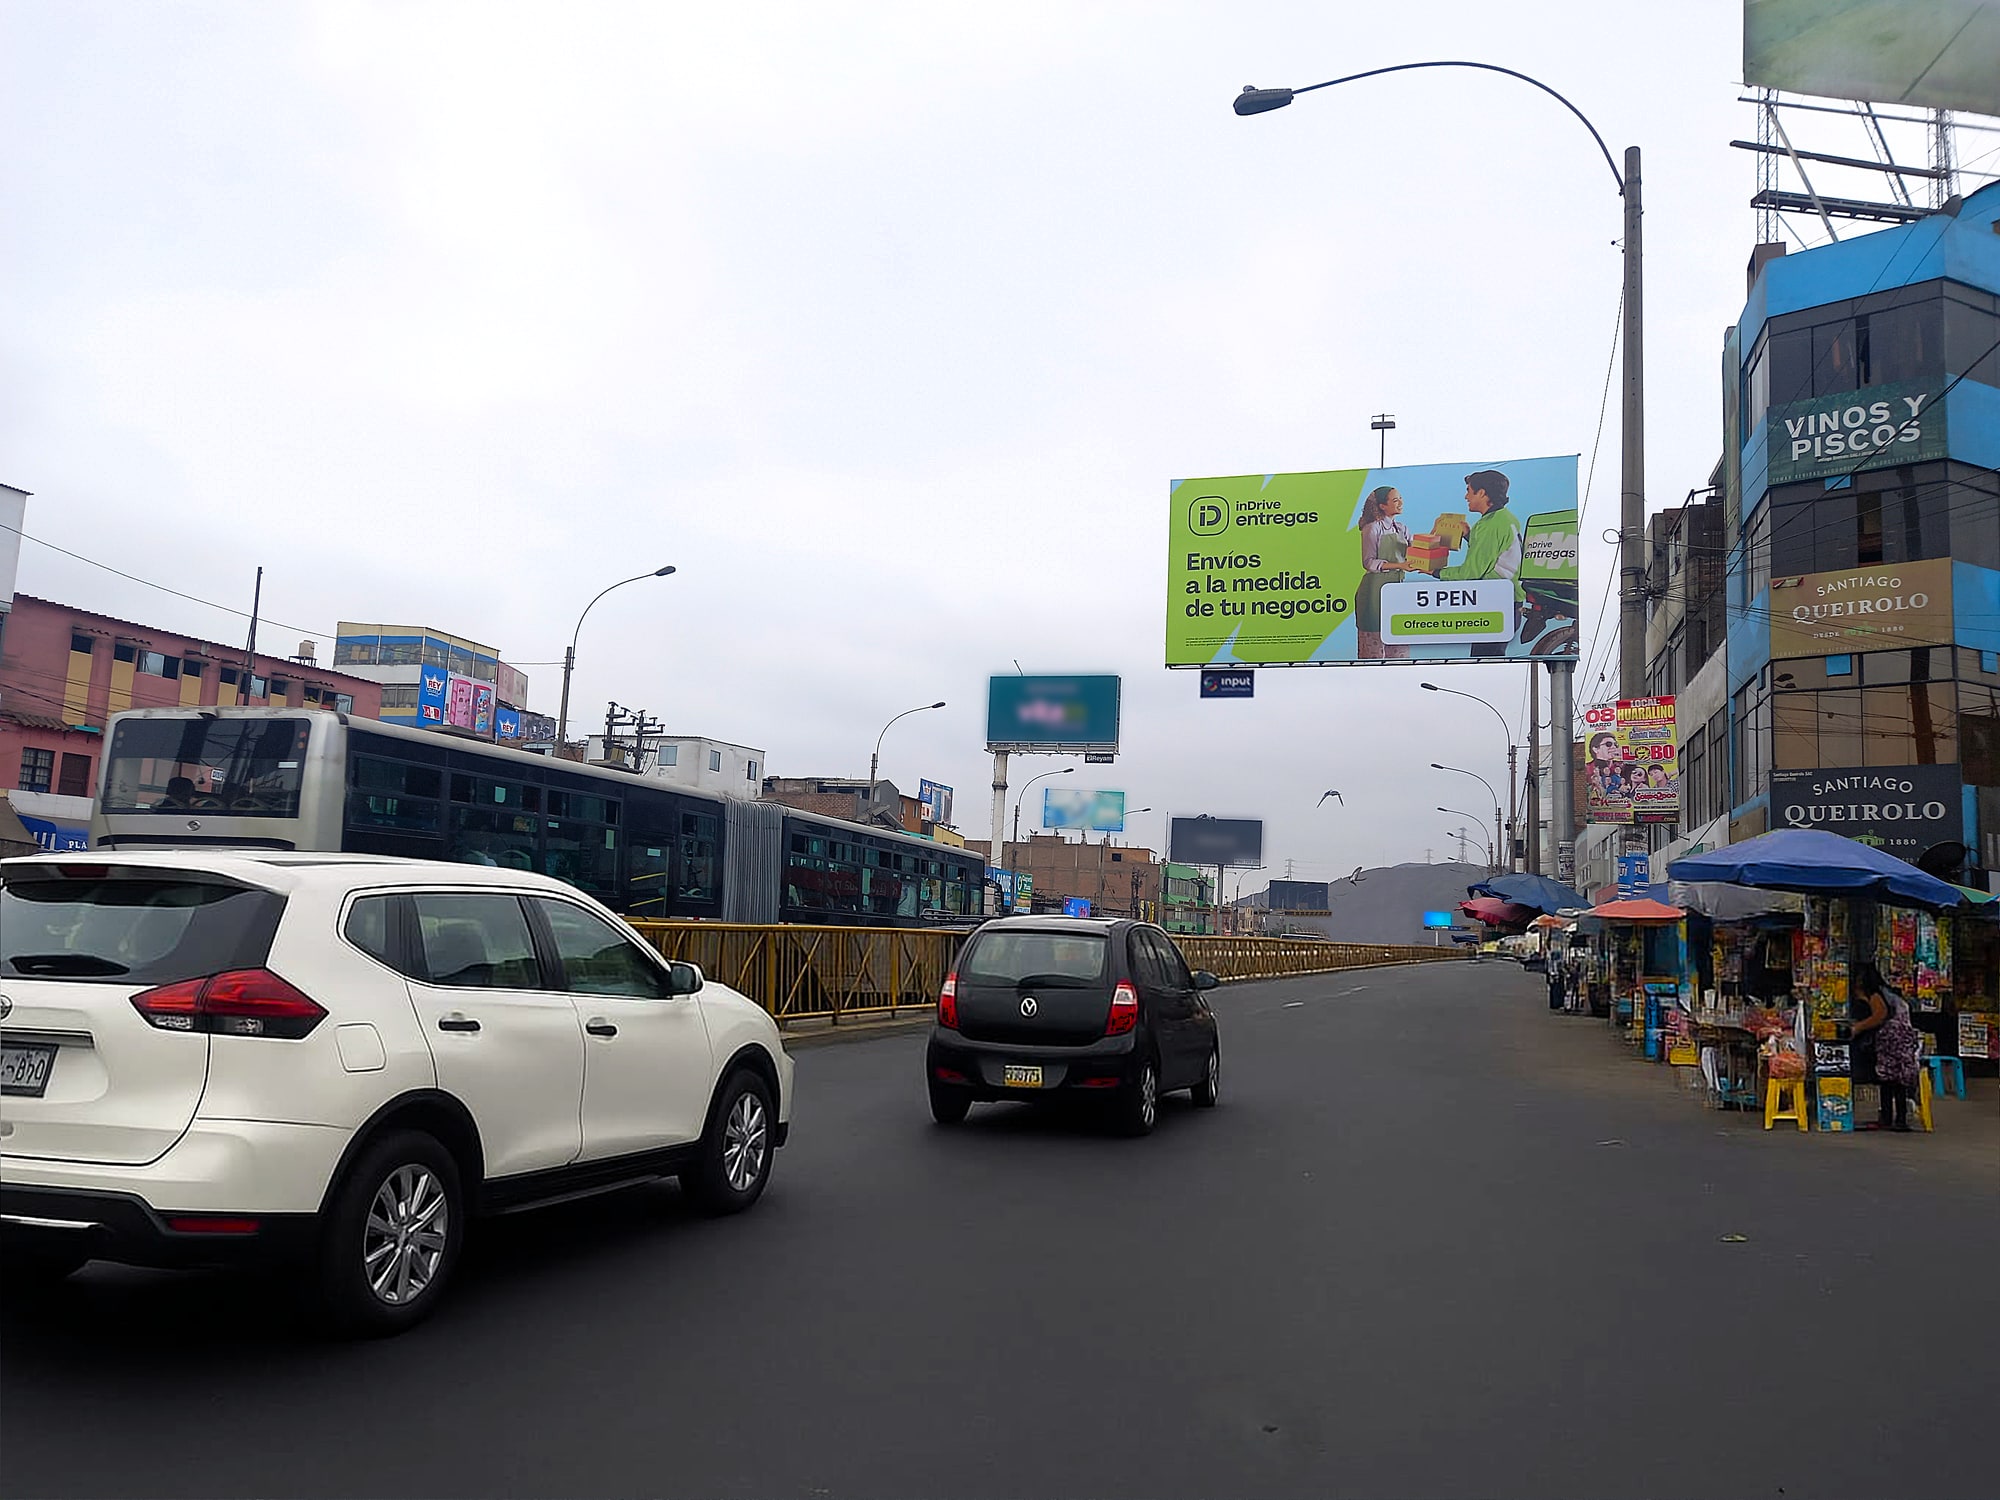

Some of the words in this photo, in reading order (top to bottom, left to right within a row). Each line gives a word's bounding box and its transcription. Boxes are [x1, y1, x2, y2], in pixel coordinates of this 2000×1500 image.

[1785, 401, 1890, 438] VINOS
[1903, 394, 1927, 417] Y
[1791, 420, 1921, 461] PISCOS
[1236, 500, 1281, 511] inDrive
[1236, 511, 1318, 527] entregas
[1187, 550, 1261, 571] Envíos
[1524, 549, 1576, 560] entregas
[1186, 579, 1200, 594] a
[1206, 575, 1226, 593] la
[1232, 571, 1321, 592] medida
[1816, 576, 1902, 597] SANTIAGO
[1185, 599, 1214, 617] de
[1220, 599, 1245, 616] tu
[1251, 594, 1347, 619] negocio
[1416, 591, 1429, 607] 5
[1436, 590, 1477, 607] PEN
[1792, 593, 1929, 625] QUEIROLO
[1404, 620, 1439, 629] Ofrece
[1442, 619, 1453, 628] tu
[1455, 618, 1490, 630] precio
[1220, 676, 1251, 687] input
[1585, 708, 1615, 723] 08
[1617, 705, 1675, 721] HUARALINO
[1813, 776, 1914, 796] SANTIAGO
[1784, 801, 1947, 829] QUEIROLO
[1889, 838, 1917, 846] 1880
